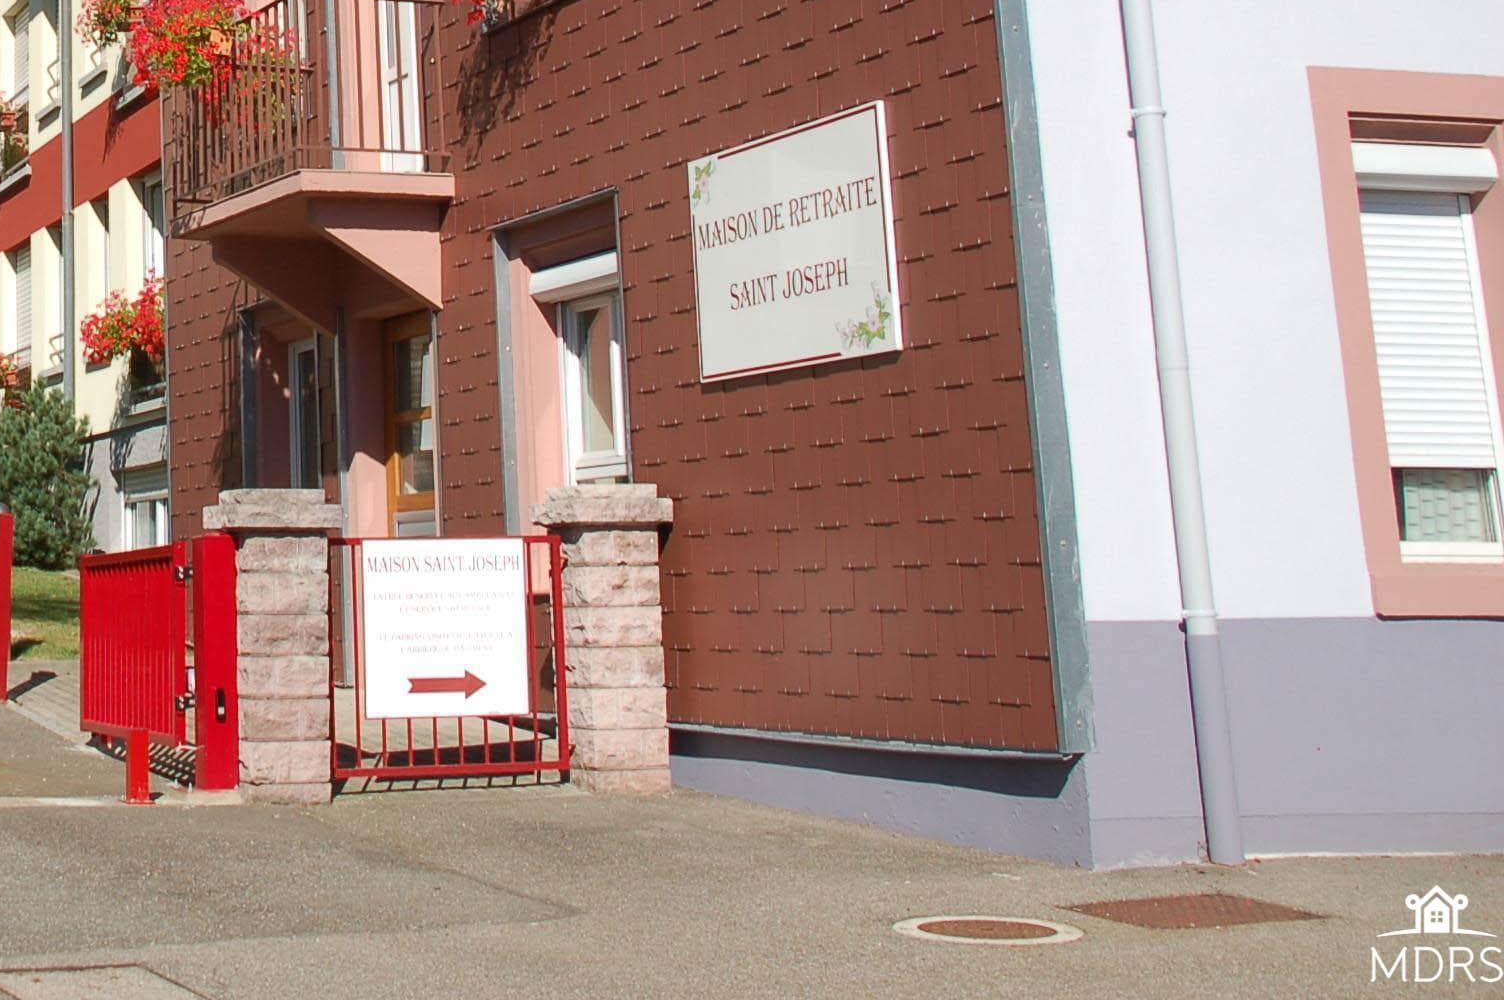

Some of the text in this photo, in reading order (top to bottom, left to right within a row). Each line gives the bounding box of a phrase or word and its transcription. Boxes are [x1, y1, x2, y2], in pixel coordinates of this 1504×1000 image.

[698, 177, 877, 250] MAISON DE RETRAITE
[729, 257, 849, 311] SAINT JOSEPH
[368, 554, 520, 573] MAISON SAINT JOSEPH
